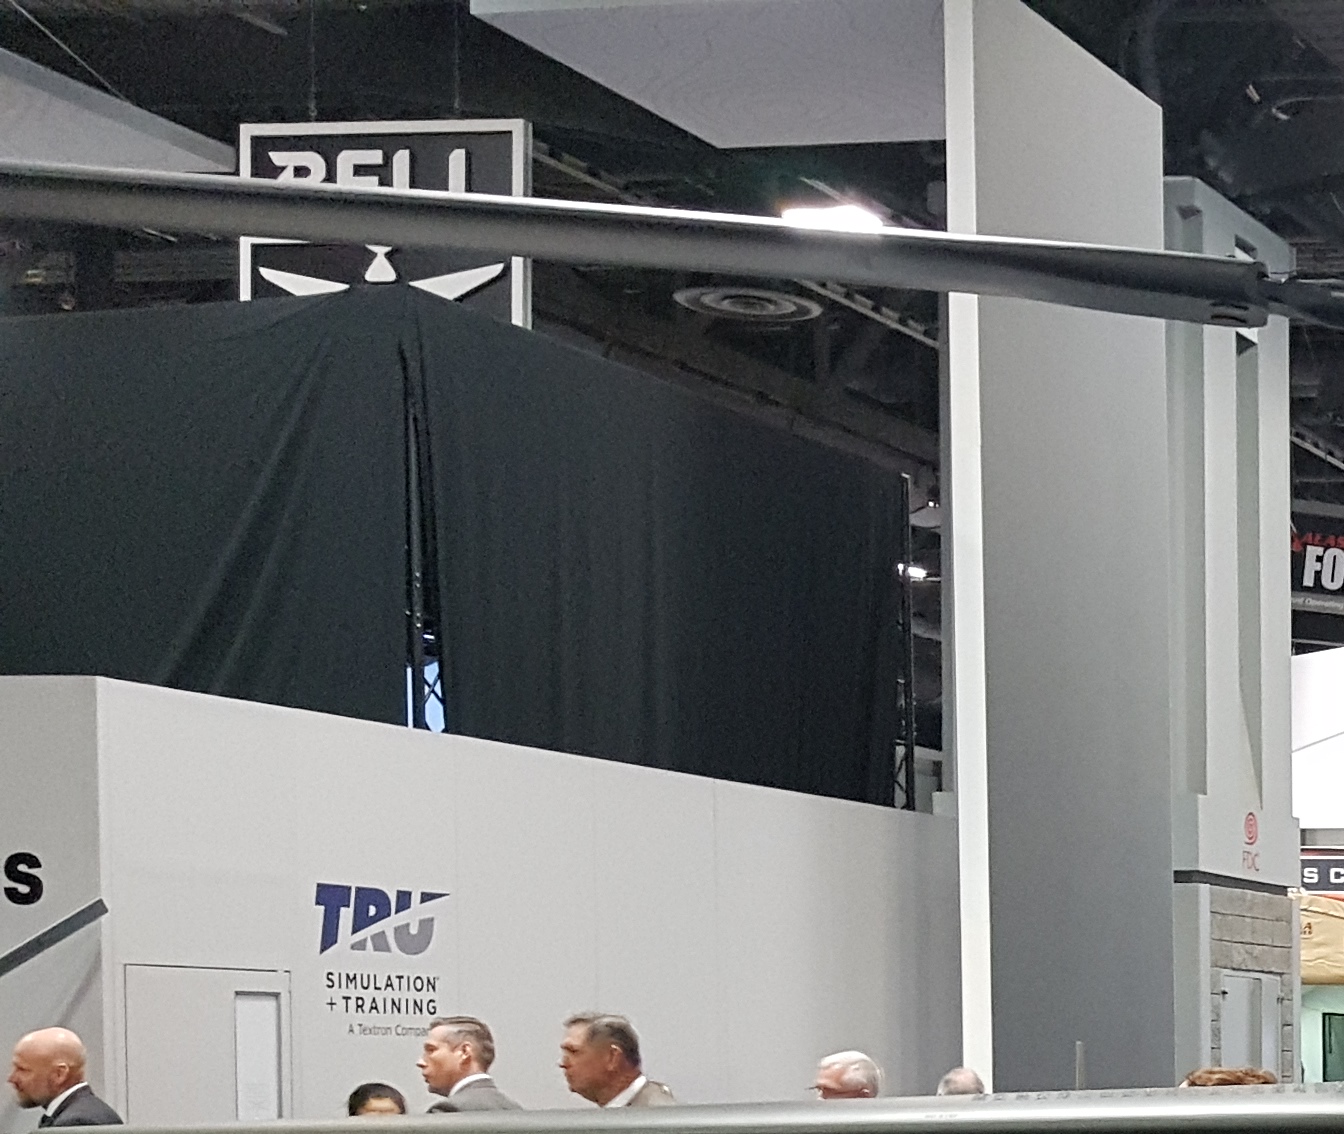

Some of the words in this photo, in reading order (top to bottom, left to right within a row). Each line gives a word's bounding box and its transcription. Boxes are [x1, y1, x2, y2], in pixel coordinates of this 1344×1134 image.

[315, 882, 450, 955] TRU
[325, 971, 439, 992] SIMULATION
[347, 1023, 355, 1035] A
[357, 1023, 392, 1036] Textron
